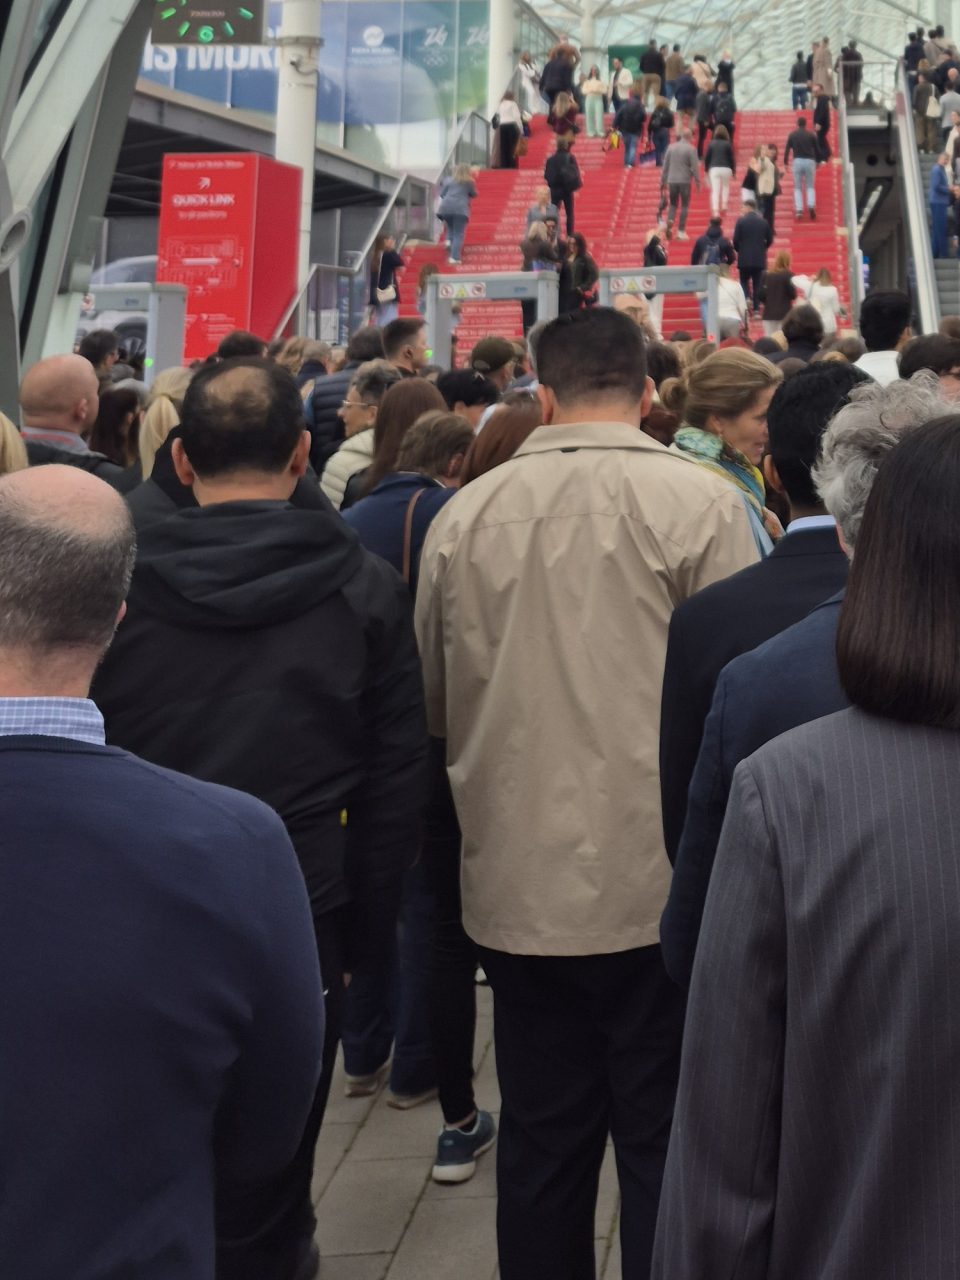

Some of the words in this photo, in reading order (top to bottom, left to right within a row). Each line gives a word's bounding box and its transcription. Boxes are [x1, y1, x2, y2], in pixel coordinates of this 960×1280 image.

[198, 25, 215, 43] 6
[172, 193, 208, 207] QUICK
[210, 193, 235, 206] LINK
